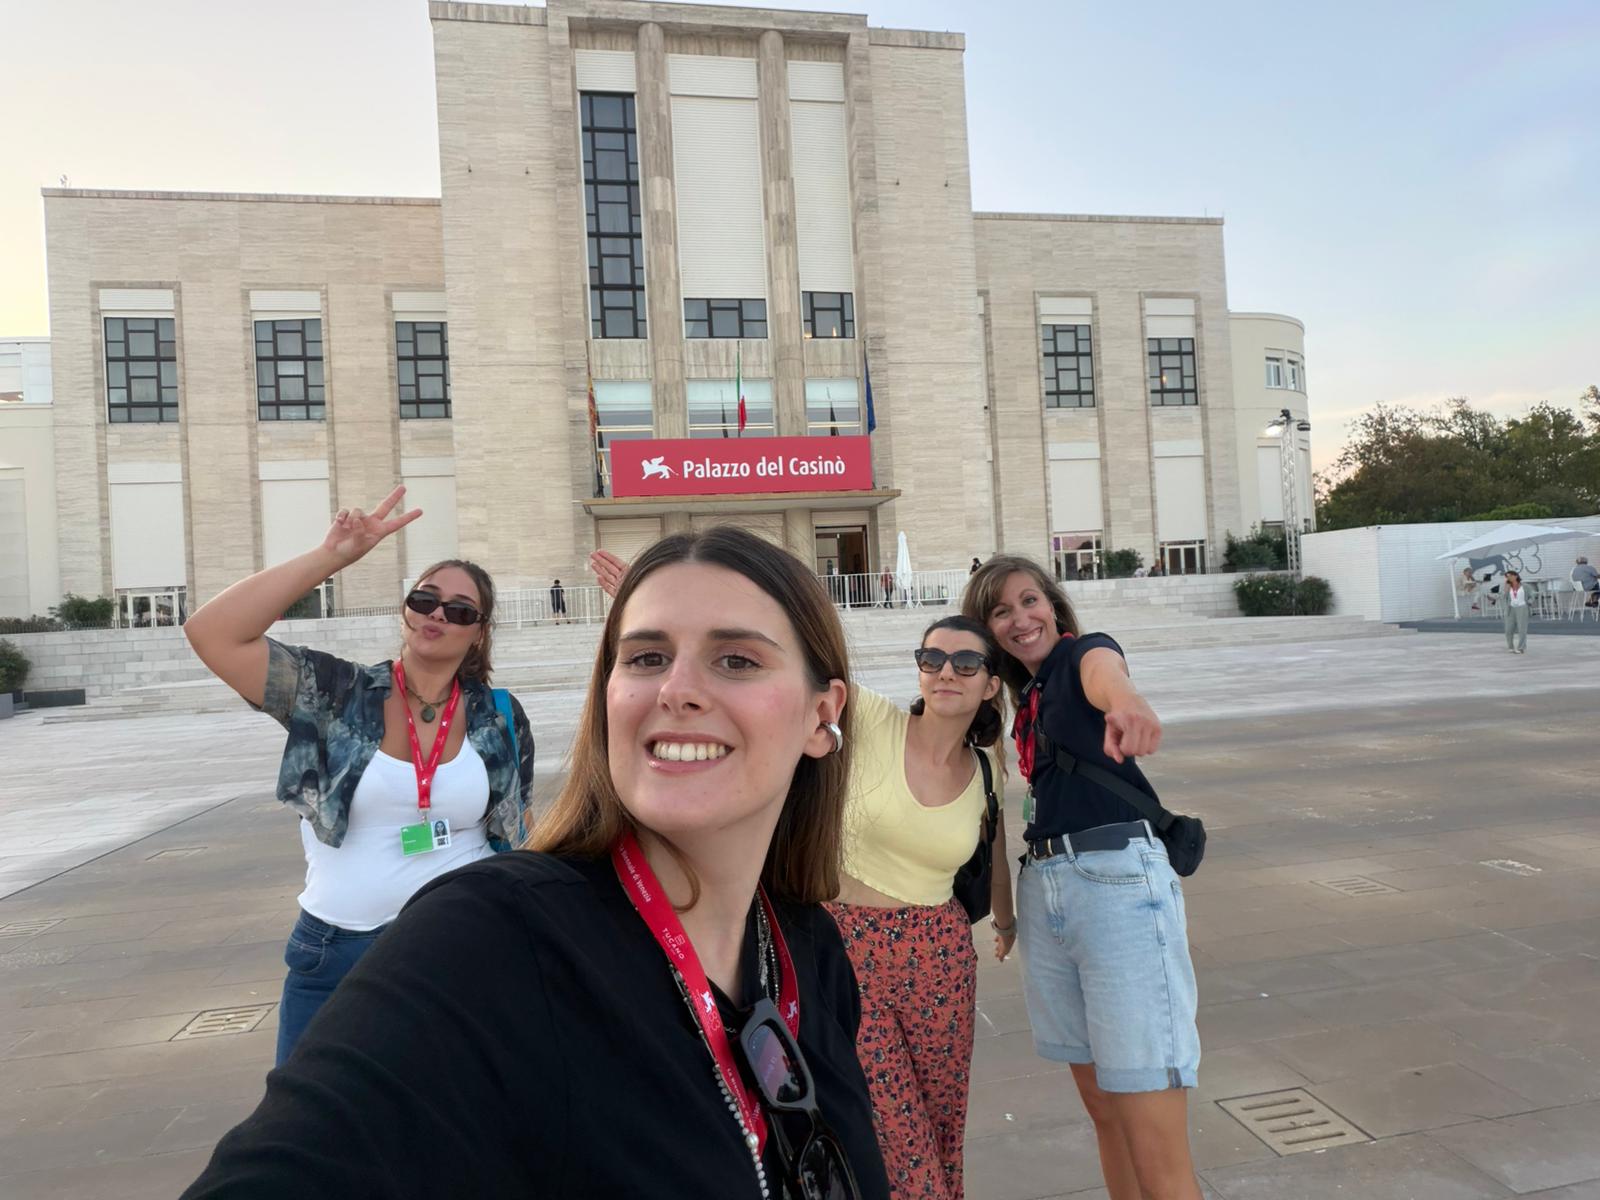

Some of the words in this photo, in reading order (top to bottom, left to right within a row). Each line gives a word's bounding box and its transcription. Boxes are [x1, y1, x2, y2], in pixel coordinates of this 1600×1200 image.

[683, 458, 750, 479] Palazzo
[756, 456, 783, 476] del
[789, 455, 846, 476] Casinò
[662, 928, 684, 959] TUCANO
